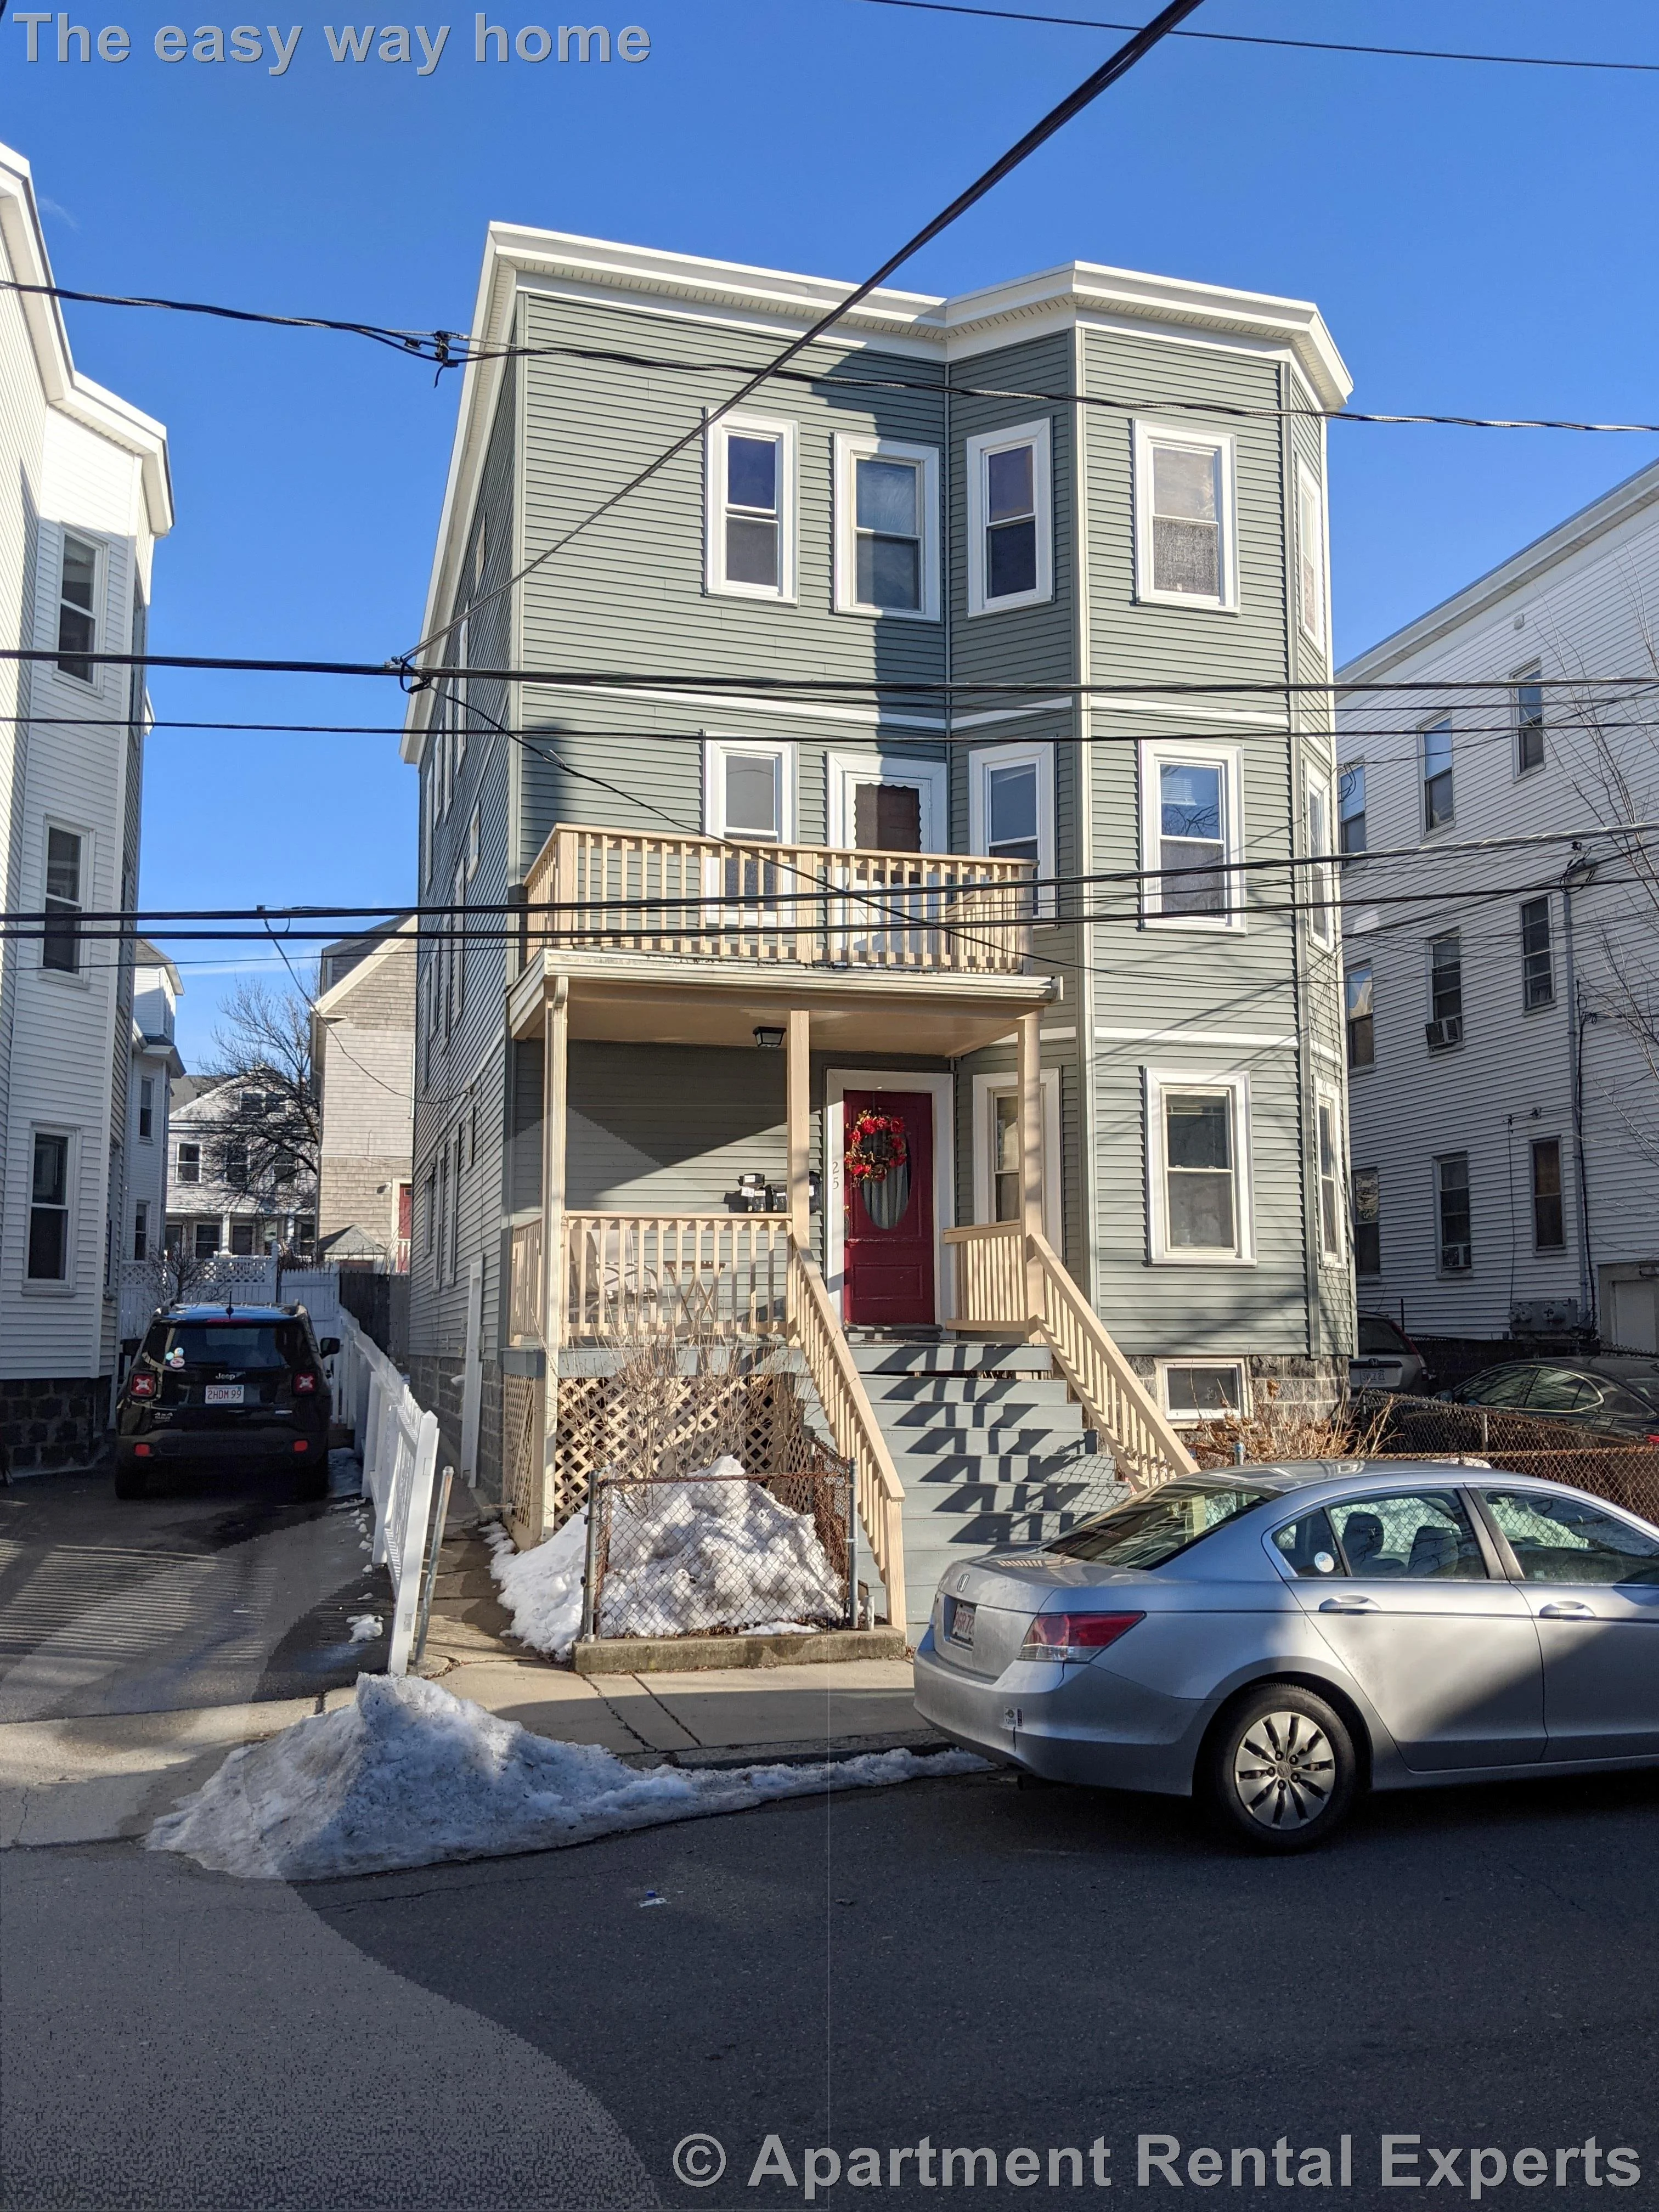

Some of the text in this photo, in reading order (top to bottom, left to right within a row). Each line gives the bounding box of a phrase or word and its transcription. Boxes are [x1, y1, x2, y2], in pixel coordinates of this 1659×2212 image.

[215, 1373, 235, 1381] Jeep
[207, 1389, 242, 1400] 2HDM 99
